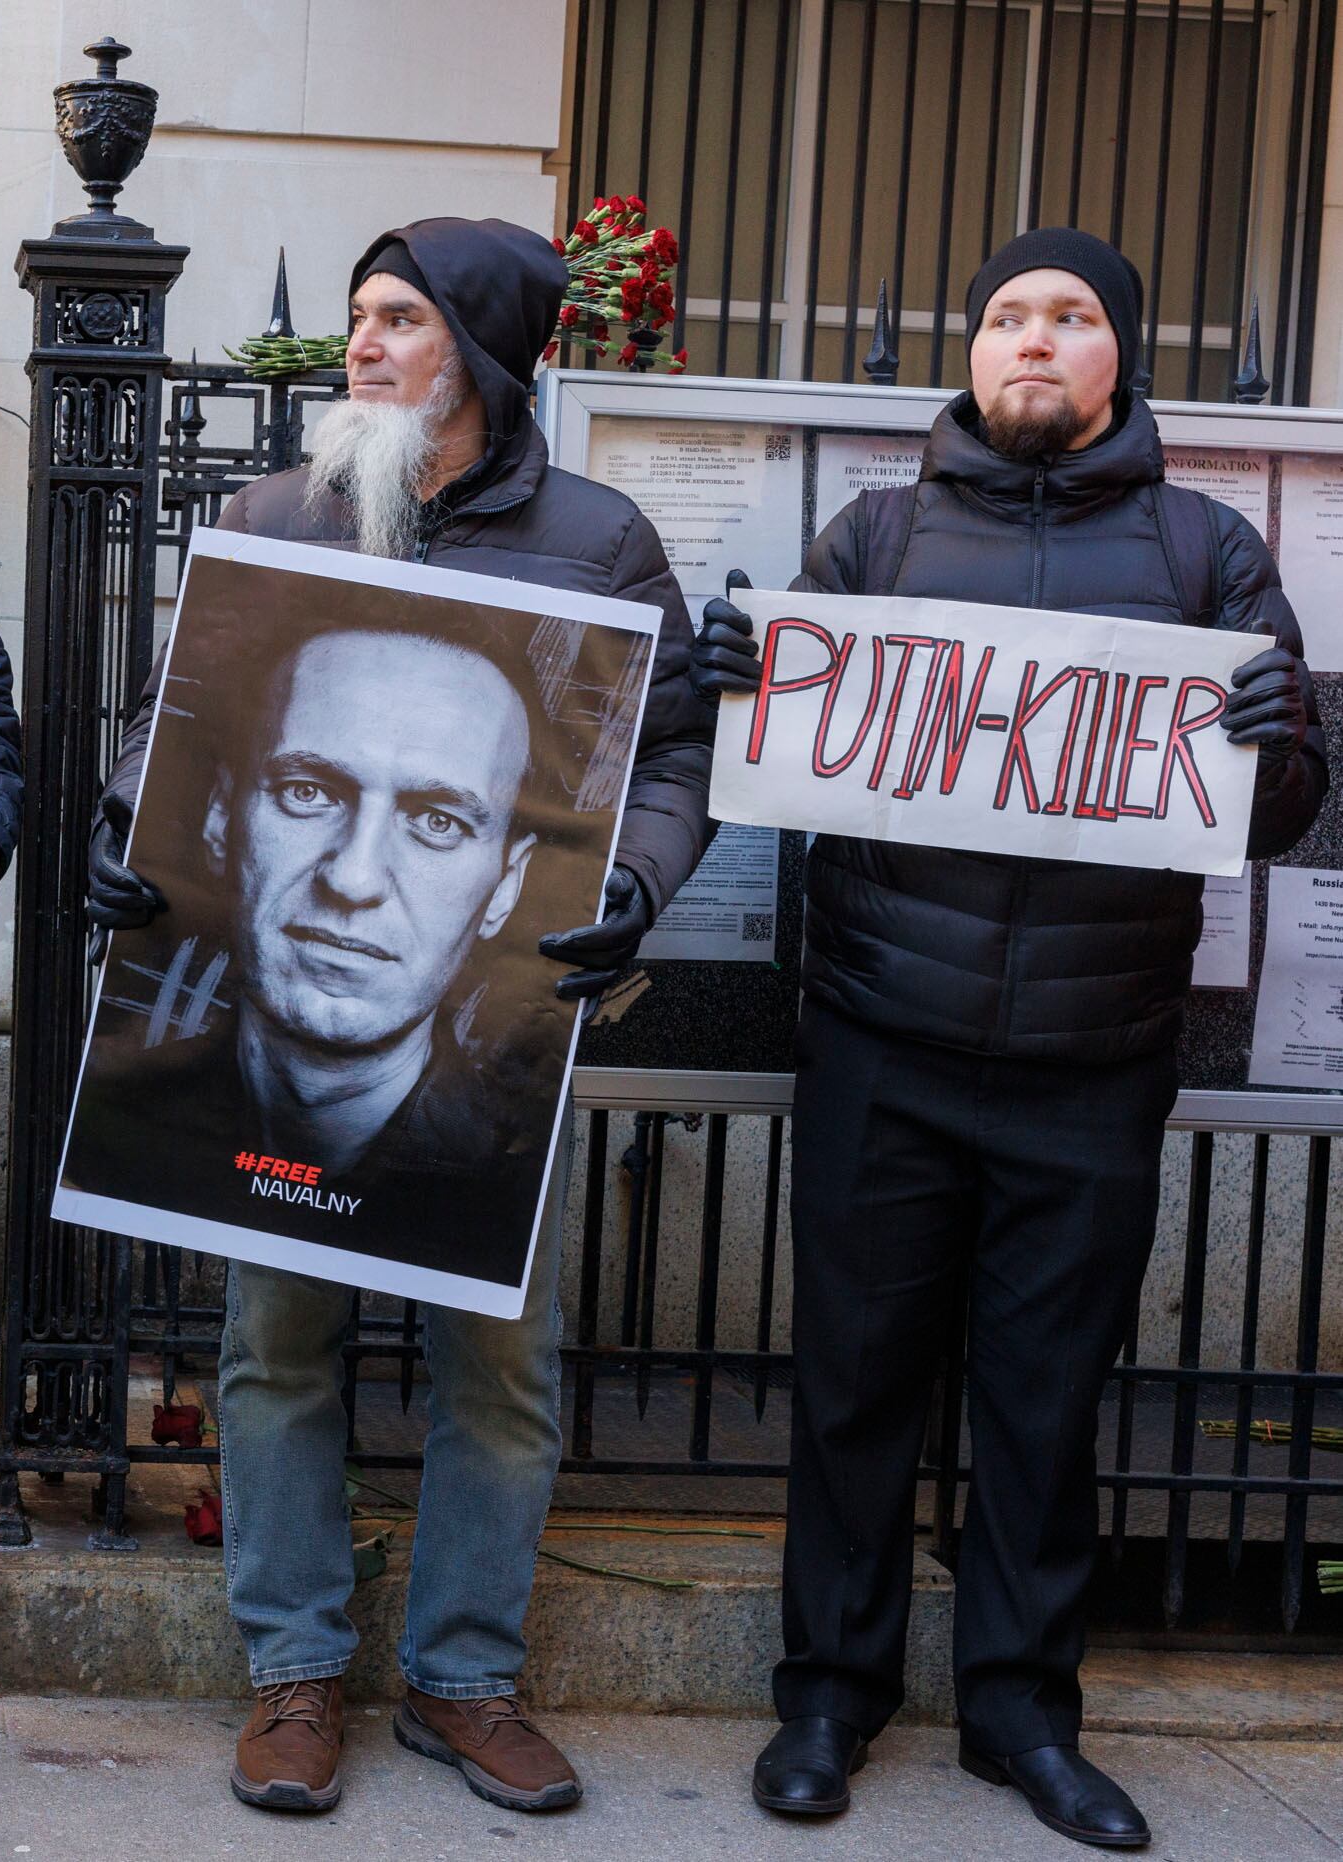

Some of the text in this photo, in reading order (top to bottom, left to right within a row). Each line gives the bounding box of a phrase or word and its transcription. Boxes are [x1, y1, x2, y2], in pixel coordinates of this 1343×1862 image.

[1165, 457, 1261, 473] INFORMATION
[849, 480, 907, 488] ПРОВЕРЯТ
[745, 616, 1228, 828] PUTIN-KILLER
[234, 1151, 322, 1186] #FREE
[251, 1175, 362, 1216] NAVALNY
